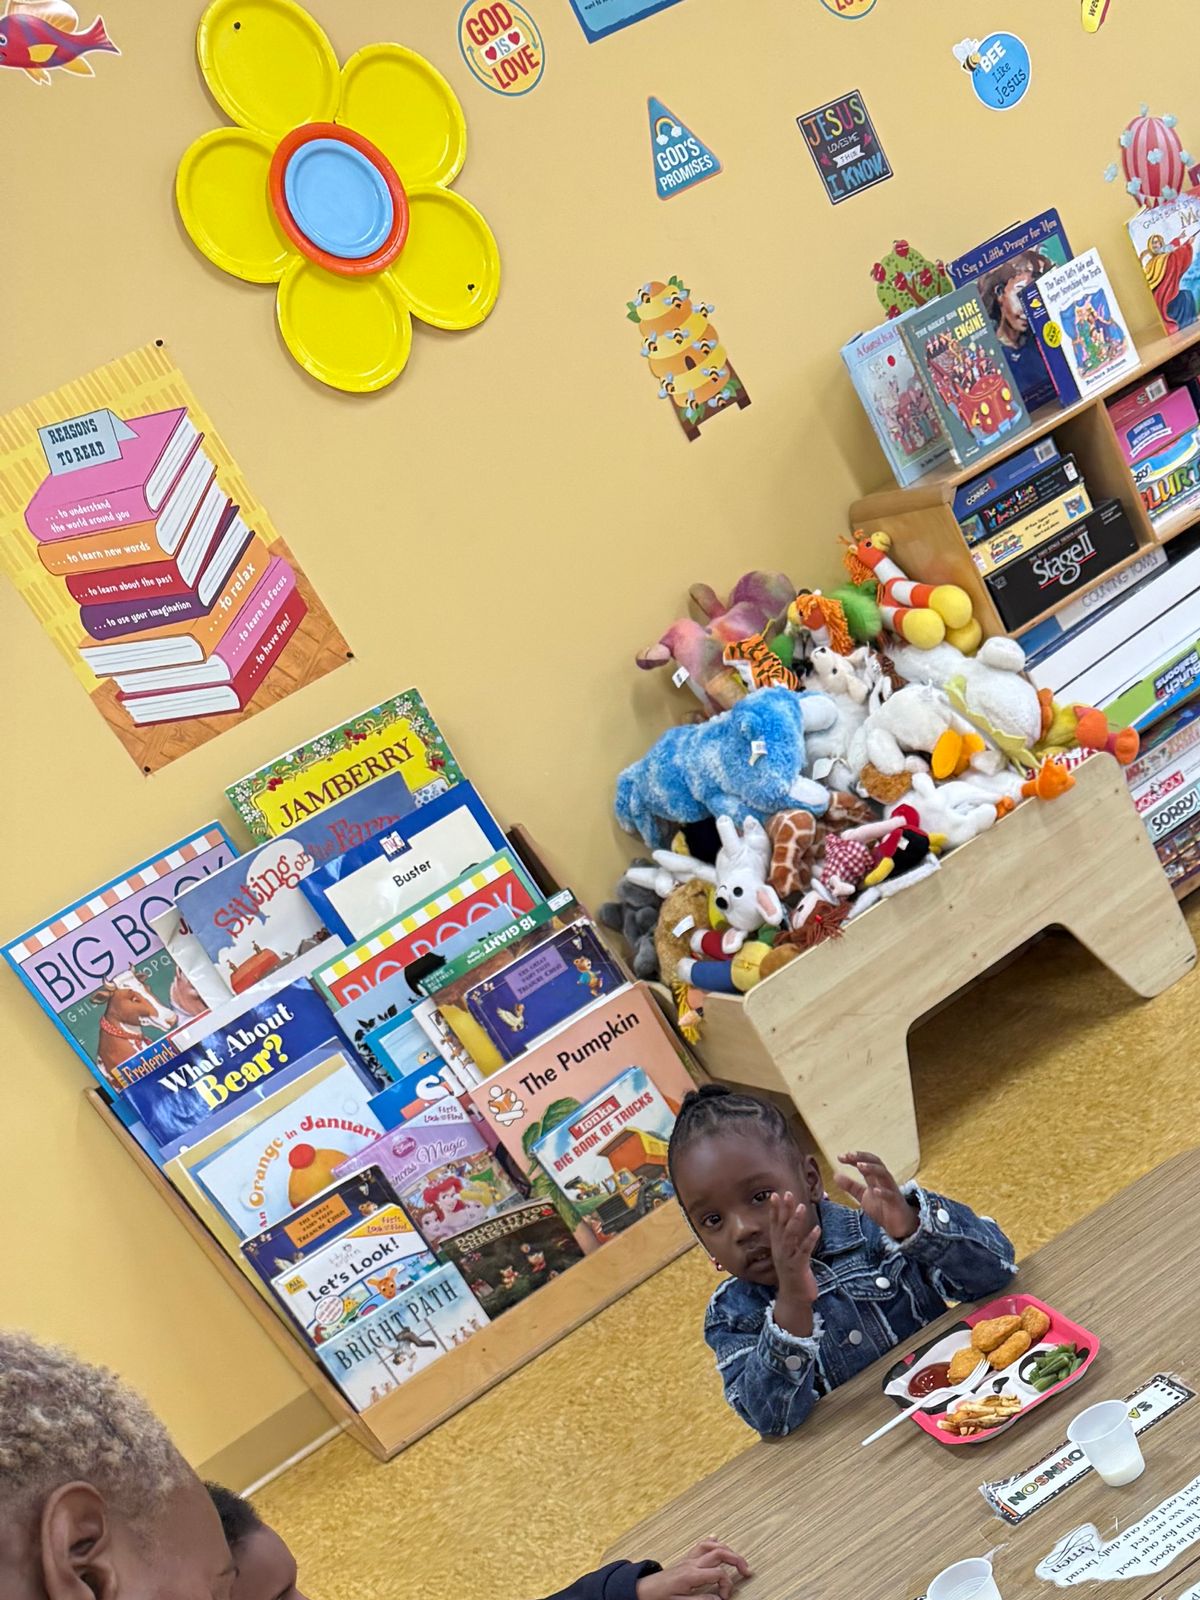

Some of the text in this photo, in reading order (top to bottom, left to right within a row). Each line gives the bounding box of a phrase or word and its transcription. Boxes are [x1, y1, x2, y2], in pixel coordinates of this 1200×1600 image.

[466, 2, 513, 47] GOD
[495, 37, 511, 56] IS
[980, 40, 1006, 74] BEE
[491, 44, 541, 90] LOVE
[992, 62, 1012, 84] Like
[995, 68, 1027, 105] Jesus
[802, 97, 866, 147] JESUS
[656, 137, 701, 172] GOD'S
[659, 154, 713, 191] PROMISES
[827, 174, 845, 198] I
[984, 247, 1004, 265] Little
[1005, 236, 1029, 255] Prayer
[1029, 228, 1041, 243] for
[957, 299, 980, 321] FIRE
[954, 314, 986, 343] ENGINE
[48, 419, 98, 446] REASONS
[56, 441, 106, 467] TO READ
[50, 509, 130, 534] the world around you
[68, 499, 112, 519] understand
[77, 541, 152, 564] learn new words
[98, 573, 173, 596] learn about the past
[229, 562, 258, 598] relax
[117, 600, 192, 626] use your imagination
[244, 574, 288, 633] learn to focus
[264, 612, 292, 655] have fun!
[1155, 648, 1200, 688] Balloons
[280, 736, 415, 828] JAMBERRY
[1152, 790, 1199, 834] SORRY!
[393, 860, 432, 888] Buster
[213, 855, 301, 938] Sitting
[482, 914, 538, 955] 18 GIANT
[35, 936, 114, 1004] BIG
[157, 1002, 295, 1094] What About
[519, 1066, 558, 1096] The
[556, 1011, 640, 1073] Pumpkin
[121, 1042, 176, 1085] Frederick
[188, 1034, 289, 1112] Bear?
[285, 1128, 299, 1141] in
[554, 1091, 655, 1173] BIG BOOK OF TRUCKS
[417, 1137, 466, 1163] Magic
[249, 1138, 283, 1207] Orange
[259, 1211, 267, 1228] An
[456, 1222, 502, 1248] DOUGH
[502, 1215, 518, 1230] IT
[457, 1212, 541, 1254] CHRISTMAS
[307, 1272, 350, 1302] Let's
[351, 1237, 399, 1275] Look!
[333, 1279, 461, 1372] BRIGHT PATH
[1007, 1448, 1084, 1506] OHNSON
[1144, 1515, 1158, 1526] for
[1159, 1497, 1184, 1514] Lord
[1169, 1510, 1184, 1520] we
[1177, 1513, 1200, 1528] him
[1123, 1527, 1140, 1541] our
[1131, 1536, 1149, 1549] fed
[1150, 1522, 1166, 1535] are
[1162, 1529, 1177, 1541] for
[1051, 1541, 1095, 1572] Amen
[1098, 1542, 1120, 1556] daily
[1142, 1542, 1158, 1556] our
[1150, 1544, 1176, 1566] good
[1066, 1560, 1098, 1587] bread
[1116, 1557, 1140, 1575] food
